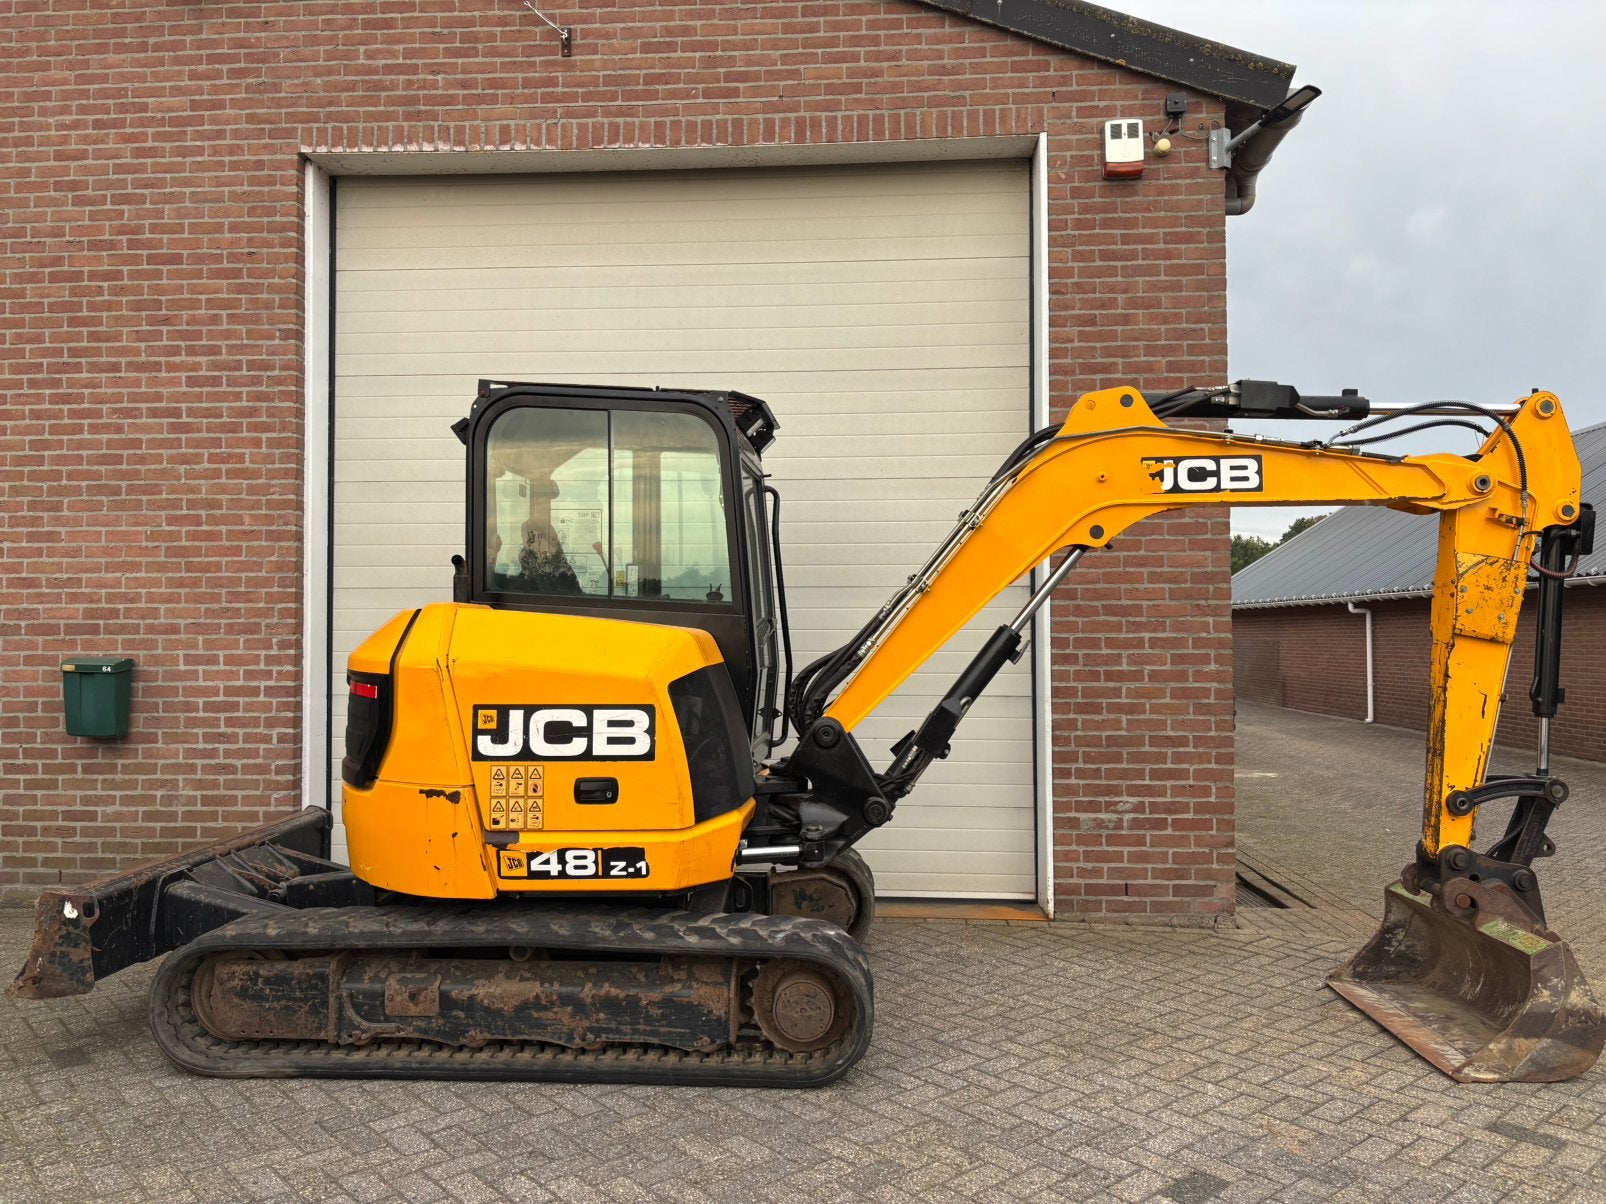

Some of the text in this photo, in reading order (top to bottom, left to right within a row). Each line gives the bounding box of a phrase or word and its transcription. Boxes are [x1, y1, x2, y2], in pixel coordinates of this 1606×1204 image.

[477, 709, 651, 757] JCB
[507, 850, 647, 876] JCB 48 Z-1
